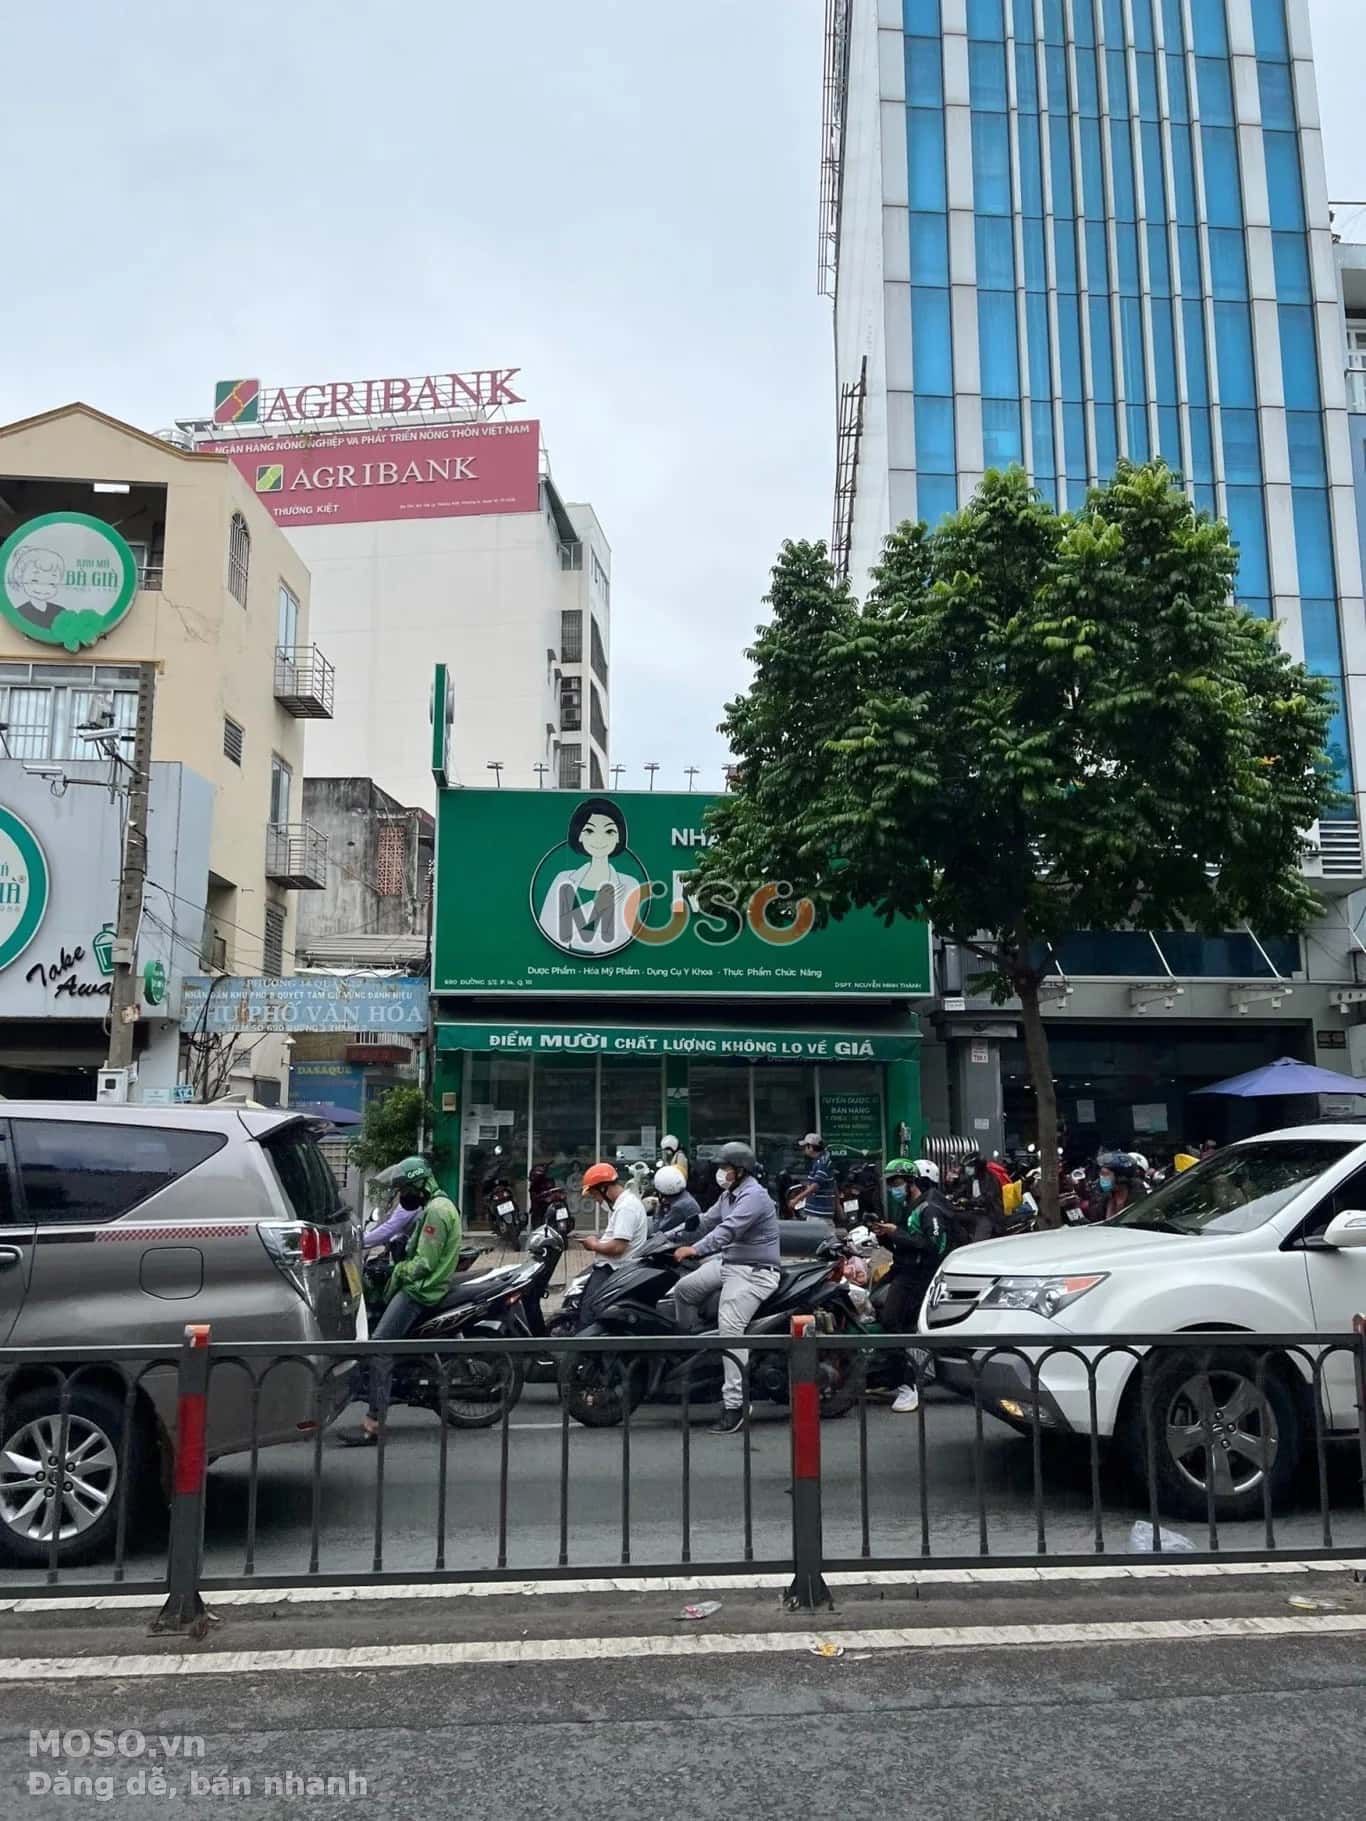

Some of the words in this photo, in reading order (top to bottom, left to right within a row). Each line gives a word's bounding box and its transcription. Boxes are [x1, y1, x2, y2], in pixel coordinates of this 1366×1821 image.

[263, 368, 526, 423] AGRIBANK
[276, 438, 305, 450] NÔNG
[419, 430, 449, 441] NÔNG
[450, 427, 479, 438] THÔN
[505, 424, 530, 434] NAM
[290, 456, 480, 491] AGRIBANK
[316, 503, 341, 514] KIỆT
[26, 945, 86, 988] Take
[527, 966, 550, 976] Dược
[551, 964, 576, 975] Phẩm
[615, 966, 640, 975] Phẩm
[646, 967, 668, 977] Dụng
[683, 968, 690, 976] Y
[691, 967, 713, 976] Khoa
[747, 965, 772, 976] Phẩm
[774, 967, 797, 977] Chức
[54, 974, 112, 999] Awa
[247, 1000, 302, 1022] PHỐ
[306, 1001, 360, 1022] VĂN
[368, 1000, 425, 1022] HÓA
[489, 1030, 533, 1047] ĐIỂM
[540, 1031, 608, 1048] MƯỜI
[614, 1035, 658, 1050] CHẤT
[663, 1038, 716, 1053] LƯỢNG
[721, 1038, 777, 1053] KHÔNG
[782, 1042, 803, 1054] LO
[834, 1039, 875, 1055] GIÁ
